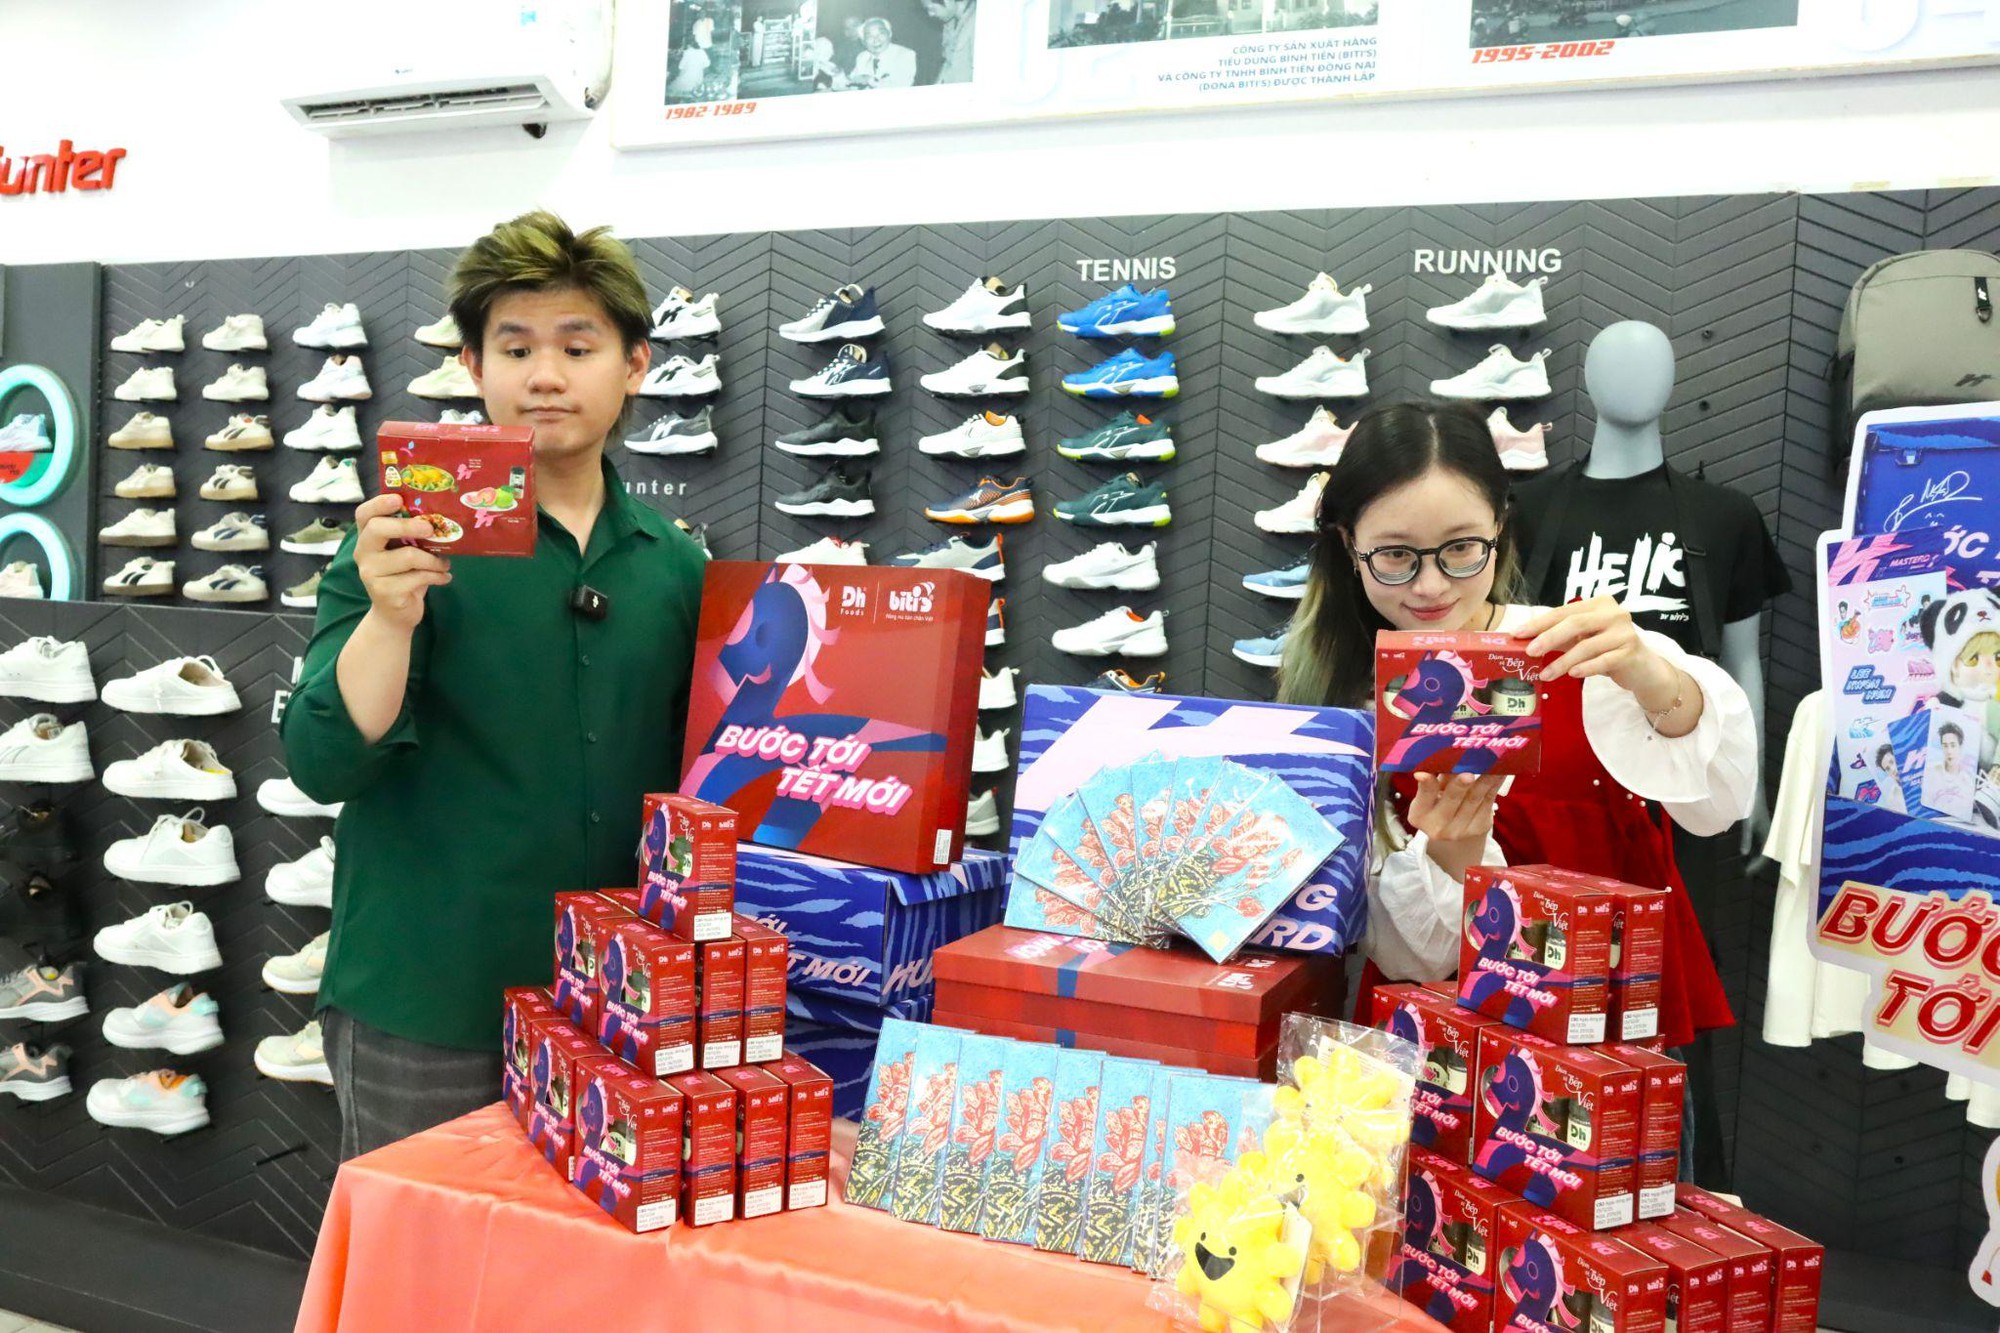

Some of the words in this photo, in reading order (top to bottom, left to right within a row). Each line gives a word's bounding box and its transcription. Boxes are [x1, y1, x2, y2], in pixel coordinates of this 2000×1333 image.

[1232, 43, 1265, 55] CÔNG
[1267, 44, 1282, 53] TY
[1343, 36, 1378, 47] HÀNG
[1244, 54, 1277, 66] DÙNG
[1279, 53, 1308, 63] BÌNH
[1471, 40, 1616, 64] 1995-2002
[1174, 70, 1207, 81] CÔNG
[1209, 69, 1223, 78] TY
[1225, 68, 1257, 78] TNHH
[1259, 65, 1288, 75] BÌNH
[1354, 61, 1376, 70] NAI
[1198, 80, 1236, 92] (DONA
[1310, 72, 1351, 84] THÀNH
[0, 139, 127, 195] unter
[1076, 256, 1177, 283] TENNIS
[1413, 248, 1563, 276] RUNNING
[1411, 722, 1469, 736] BƯỚC
[1469, 723, 1505, 736] TỚI
[1453, 735, 1486, 748] TẾT
[1484, 736, 1529, 748] MỚI
[715, 724, 807, 763] BƯỚC
[811, 735, 871, 773] TỚI
[777, 765, 840, 801] TẾT
[835, 775, 912, 815] MỚI
[803, 957, 871, 986] MỚI
[1478, 957, 1516, 979] BƯỚC
[1516, 969, 1540, 987] TỚI
[1504, 980, 1528, 997] TẾT
[1526, 988, 1558, 1008] MỚI
[1420, 1090, 1443, 1109] TỚI
[1430, 1110, 1460, 1130] MỚI
[1495, 1126, 1537, 1153] BƯỚC
[1536, 1144, 1565, 1167] TỚI
[1524, 1153, 1551, 1176] TẾT
[1547, 1168, 1584, 1189] MỚI
[1402, 1242, 1437, 1272] BƯỚC
[1437, 1264, 1461, 1286] TỚI
[1427, 1272, 1450, 1294] TẾT
[1448, 1286, 1479, 1311] MỚI
